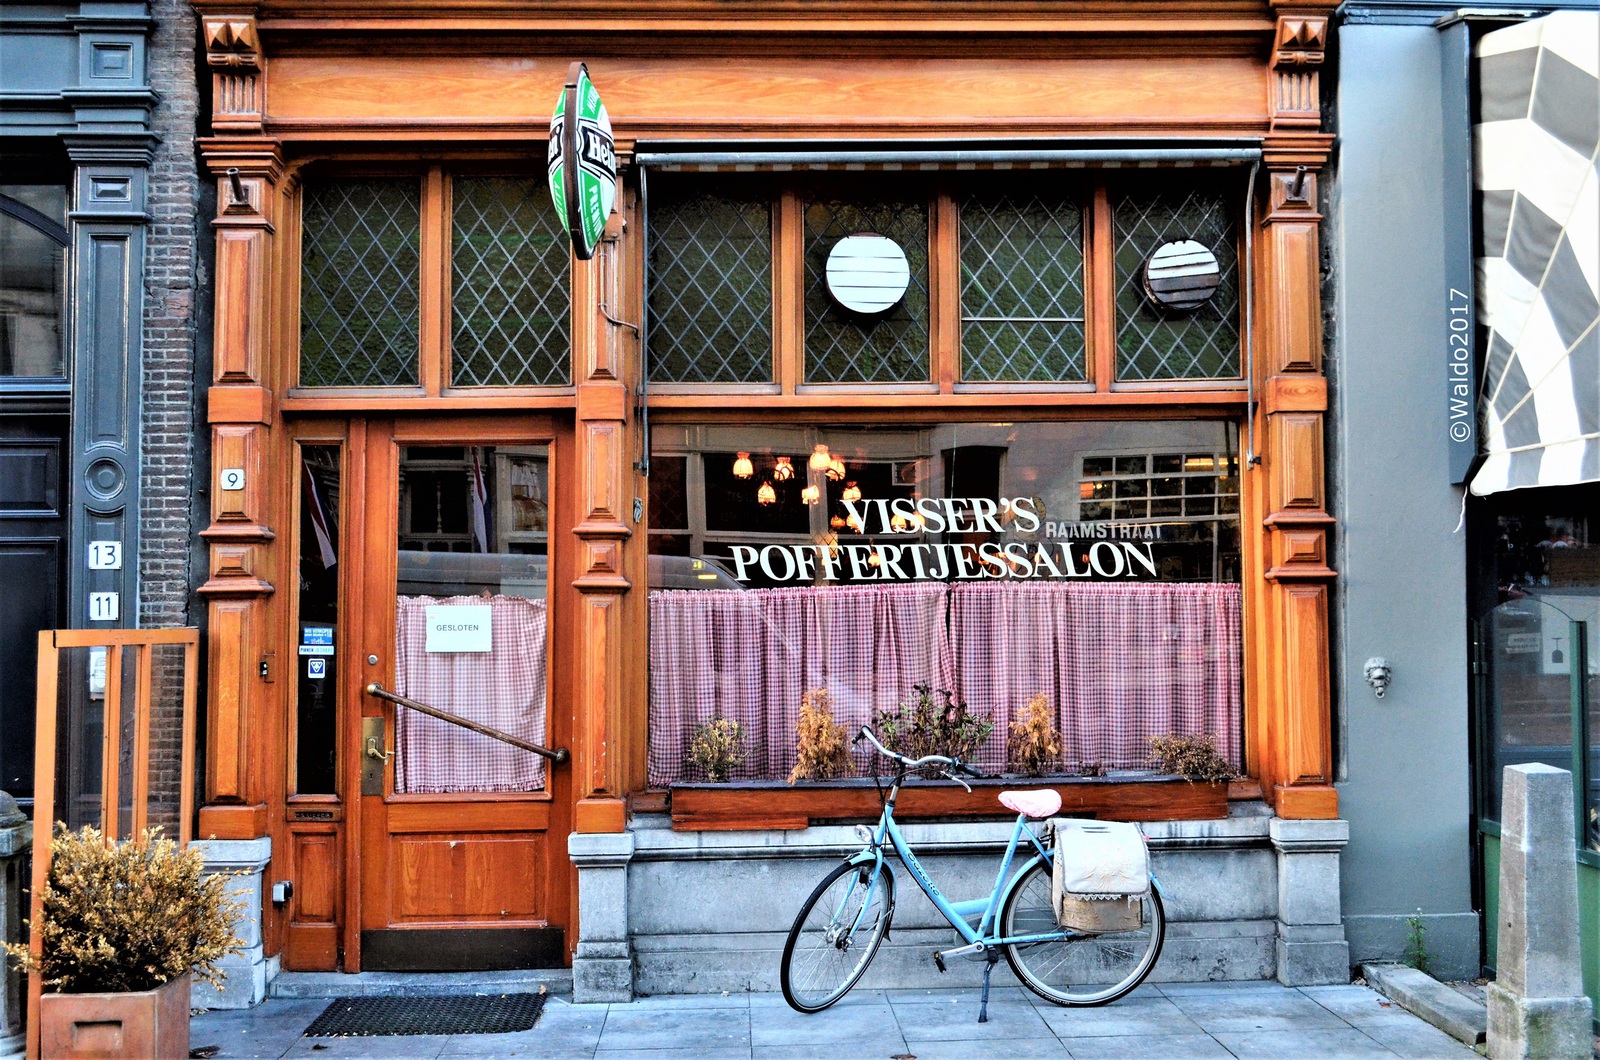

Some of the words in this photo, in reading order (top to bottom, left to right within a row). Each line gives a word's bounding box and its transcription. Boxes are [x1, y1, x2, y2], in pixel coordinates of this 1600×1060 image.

[227, 473, 238, 487] 9
[1045, 521, 1162, 539] RAAMSTRAAT
[93, 545, 116, 566] 13
[728, 541, 1159, 583] POFFERTJESSALON
[95, 596, 111, 617] 11
[436, 624, 479, 632] GESLOTEN
